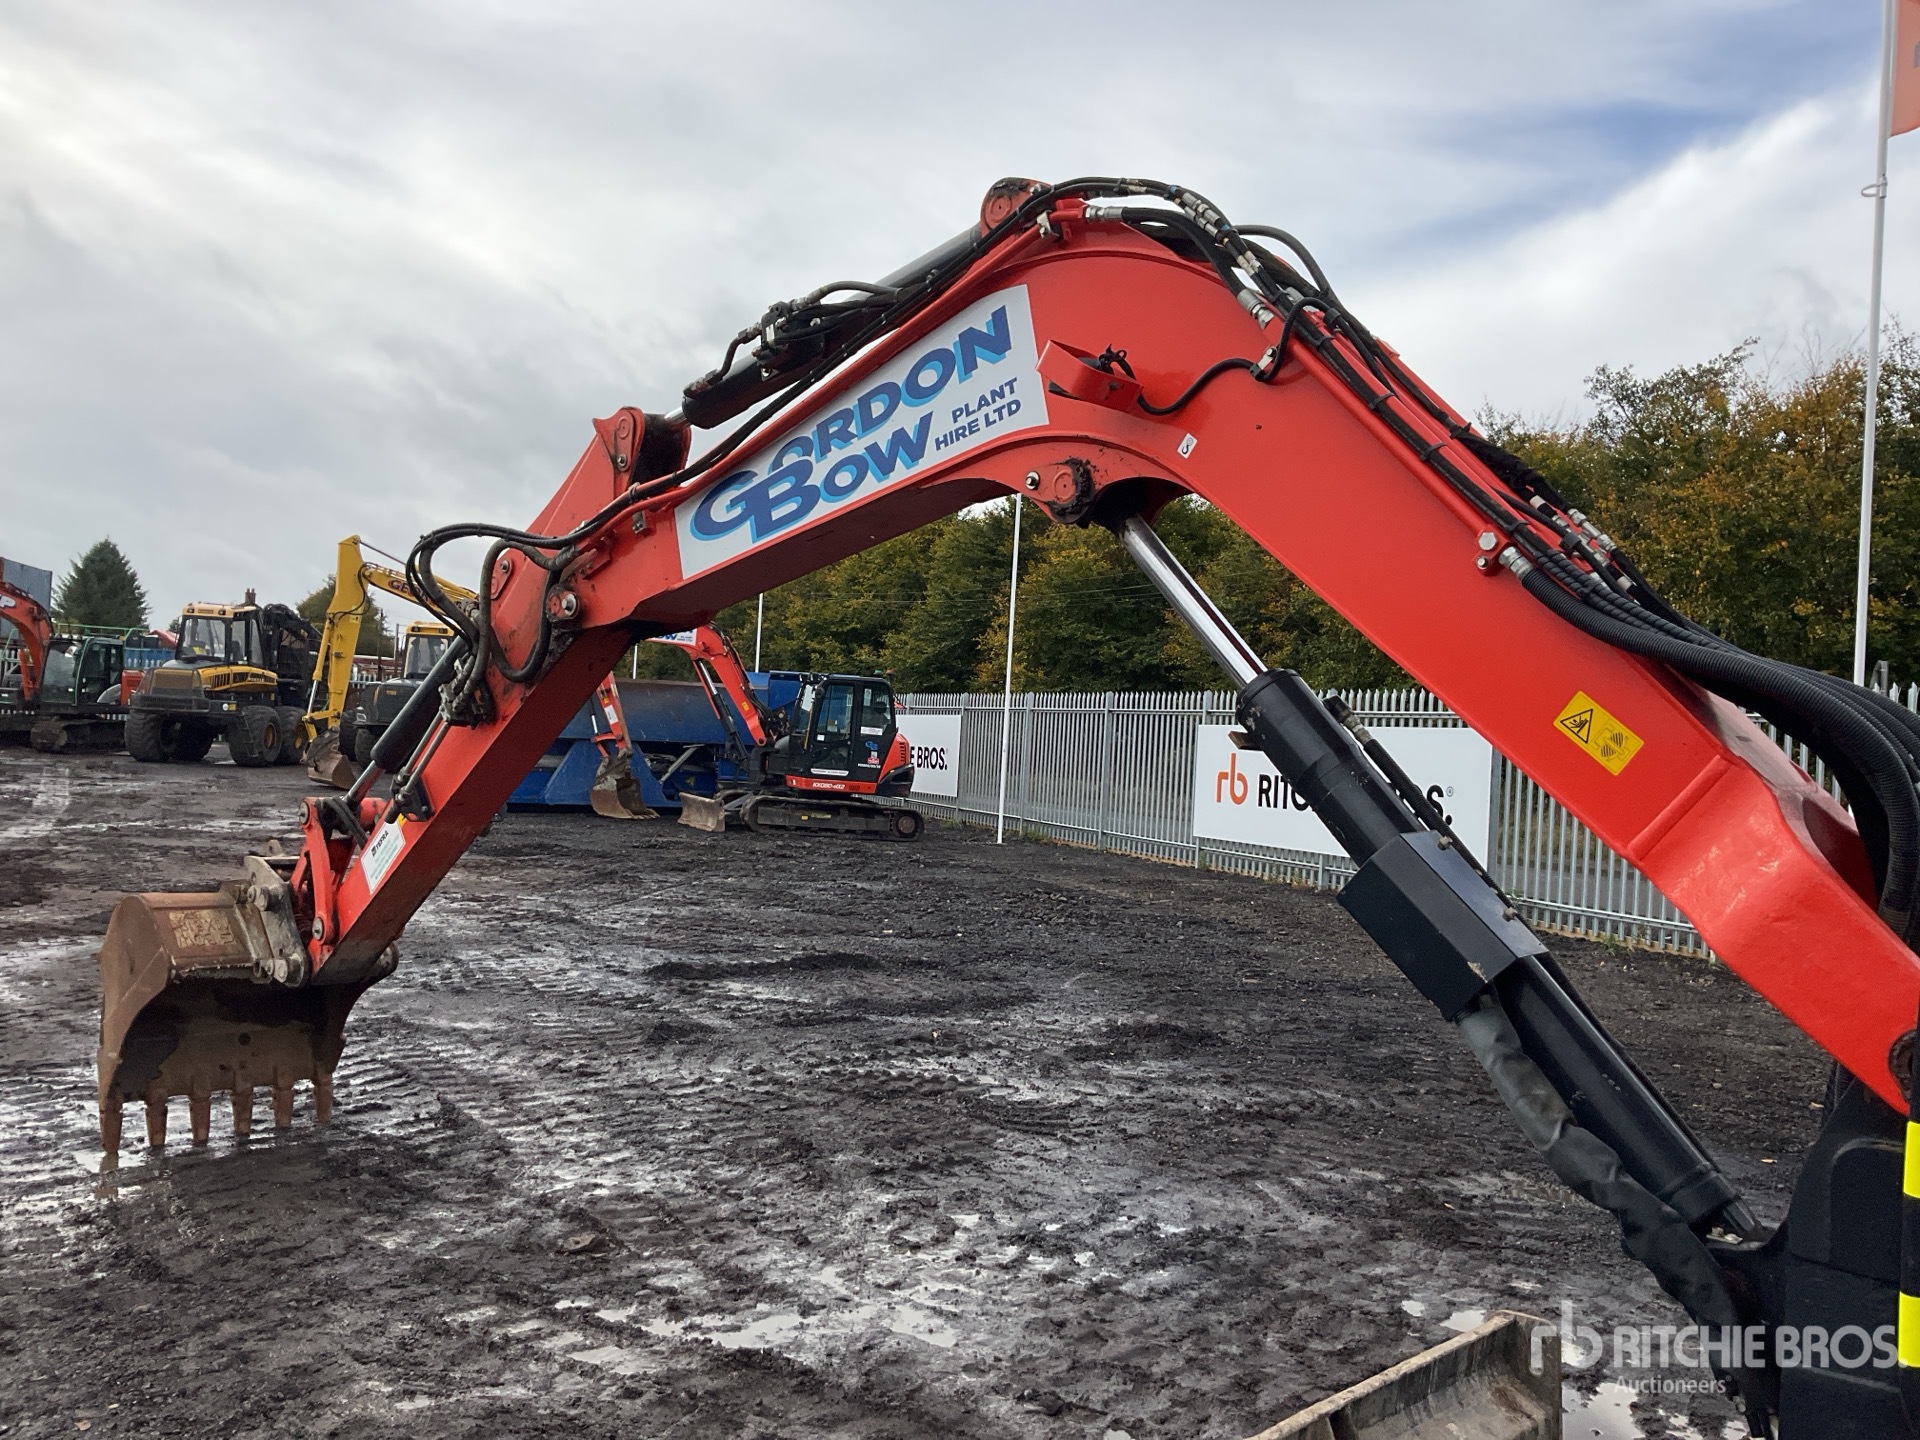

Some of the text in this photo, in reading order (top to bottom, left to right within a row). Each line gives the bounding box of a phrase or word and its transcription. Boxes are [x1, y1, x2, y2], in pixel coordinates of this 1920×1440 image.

[690, 305, 1012, 541] GORDON
[934, 399, 1022, 451] HIRE LTD
[951, 377, 1018, 424] PLANT
[736, 411, 933, 544] BOW
[916, 746, 948, 770] BROS.
